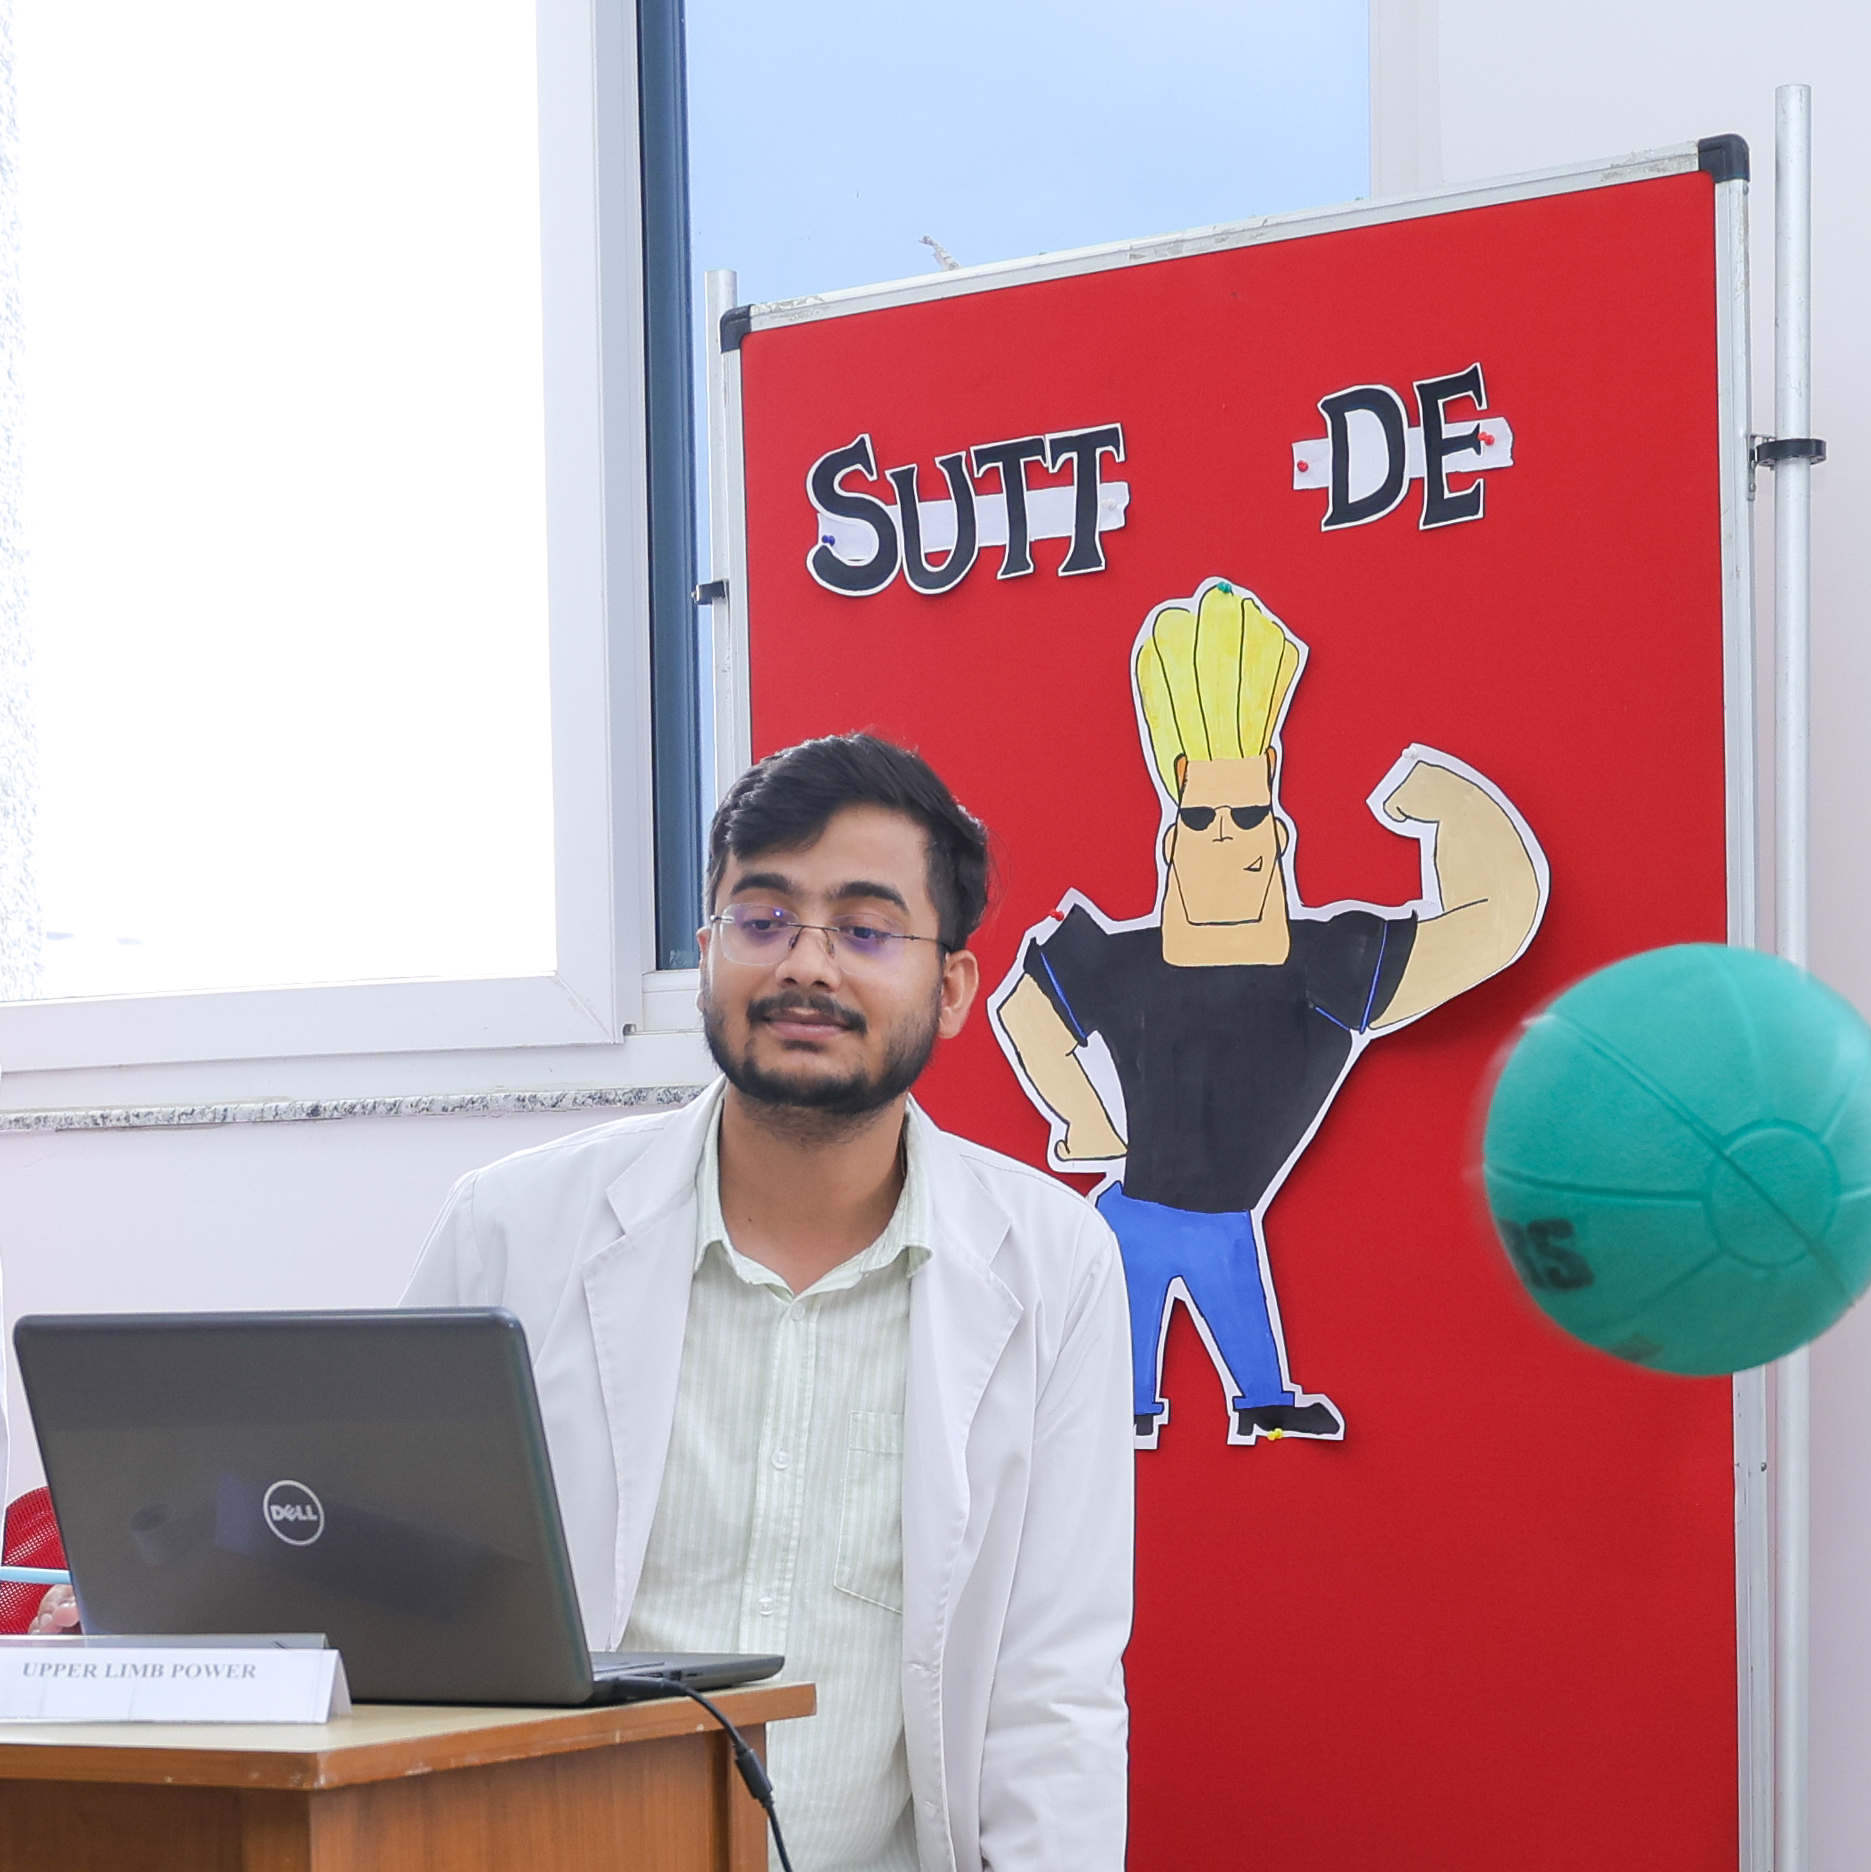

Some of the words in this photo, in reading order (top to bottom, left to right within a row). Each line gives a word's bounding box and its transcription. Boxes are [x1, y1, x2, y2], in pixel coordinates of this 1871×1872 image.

[809, 428, 1123, 596] SUTT
[1318, 364, 1488, 529] DE
[270, 1504, 318, 1521] DELL
[22, 1661, 98, 1680] UPPER
[104, 1661, 165, 1680] LIMB
[171, 1661, 258, 1680] POWER
